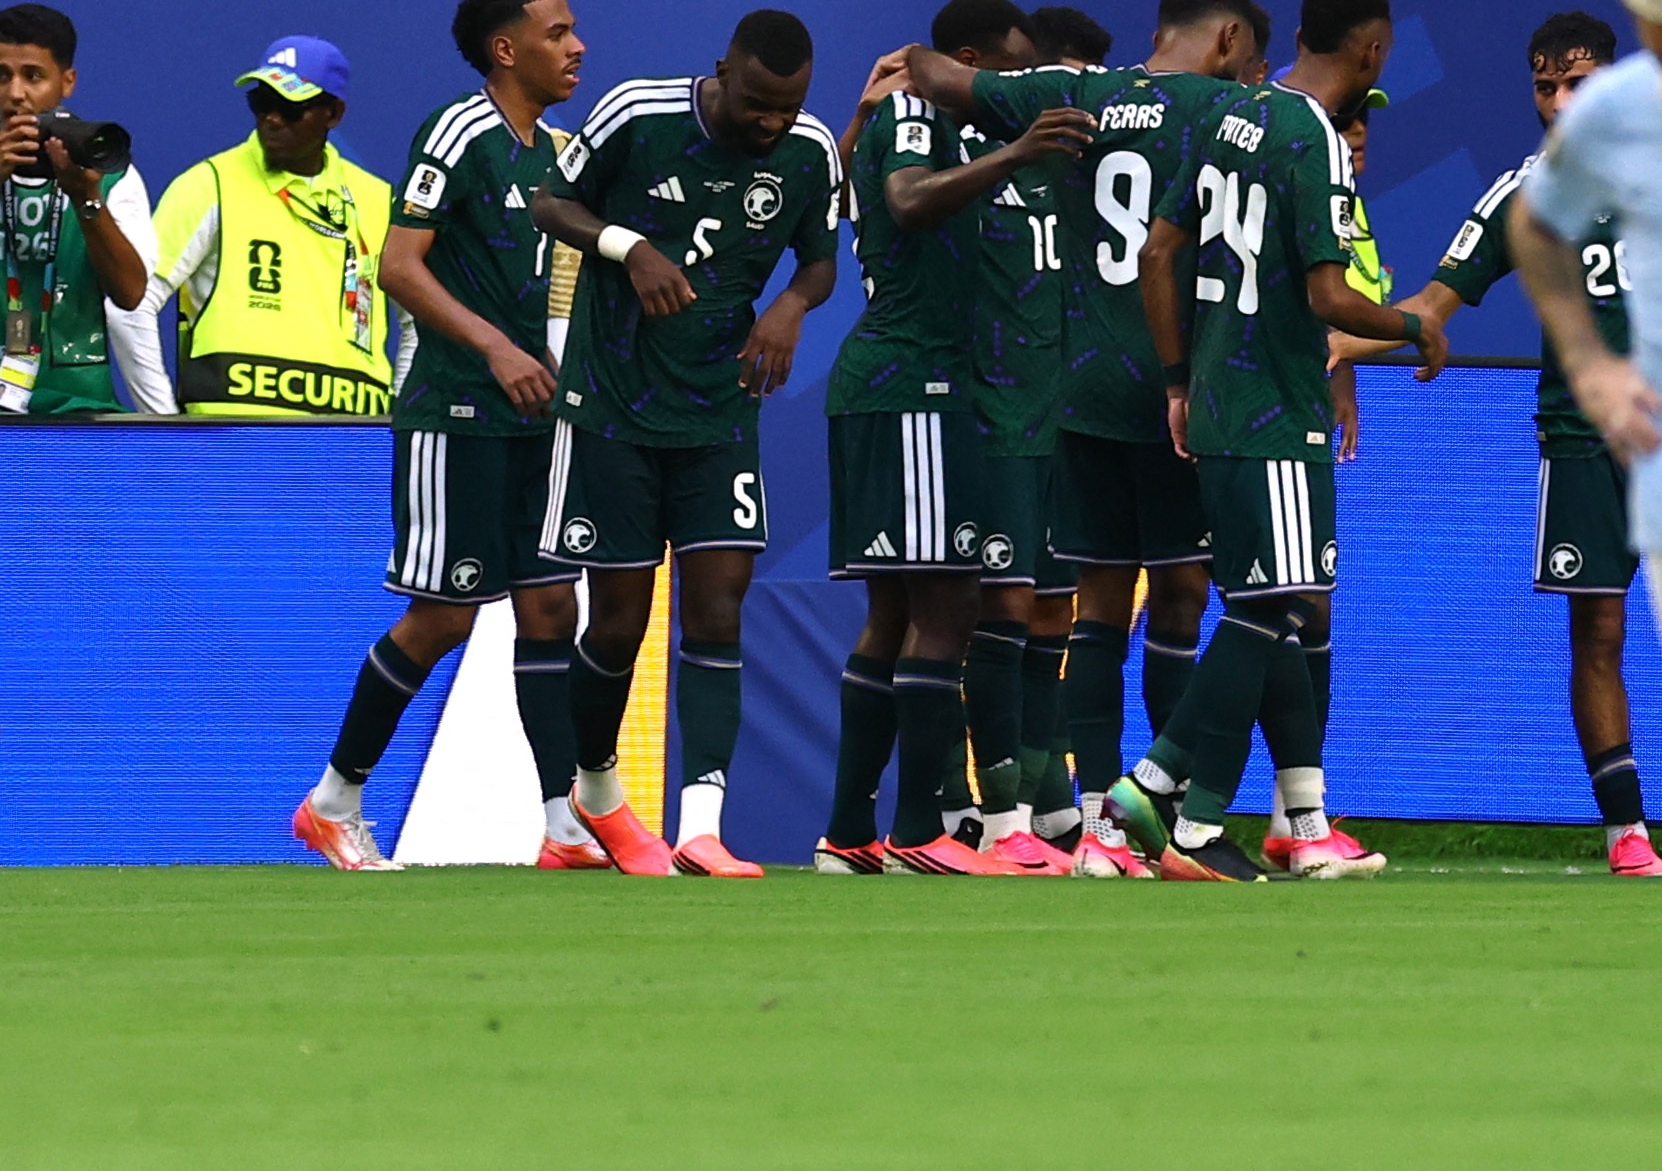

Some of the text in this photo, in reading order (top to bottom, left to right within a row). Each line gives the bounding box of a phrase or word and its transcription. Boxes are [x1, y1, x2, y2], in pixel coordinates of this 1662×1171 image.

[1100, 104, 1165, 132] FERAS
[1095, 150, 1152, 286] 9
[1196, 164, 1268, 316] 24
[228, 362, 390, 416] SECURITY
